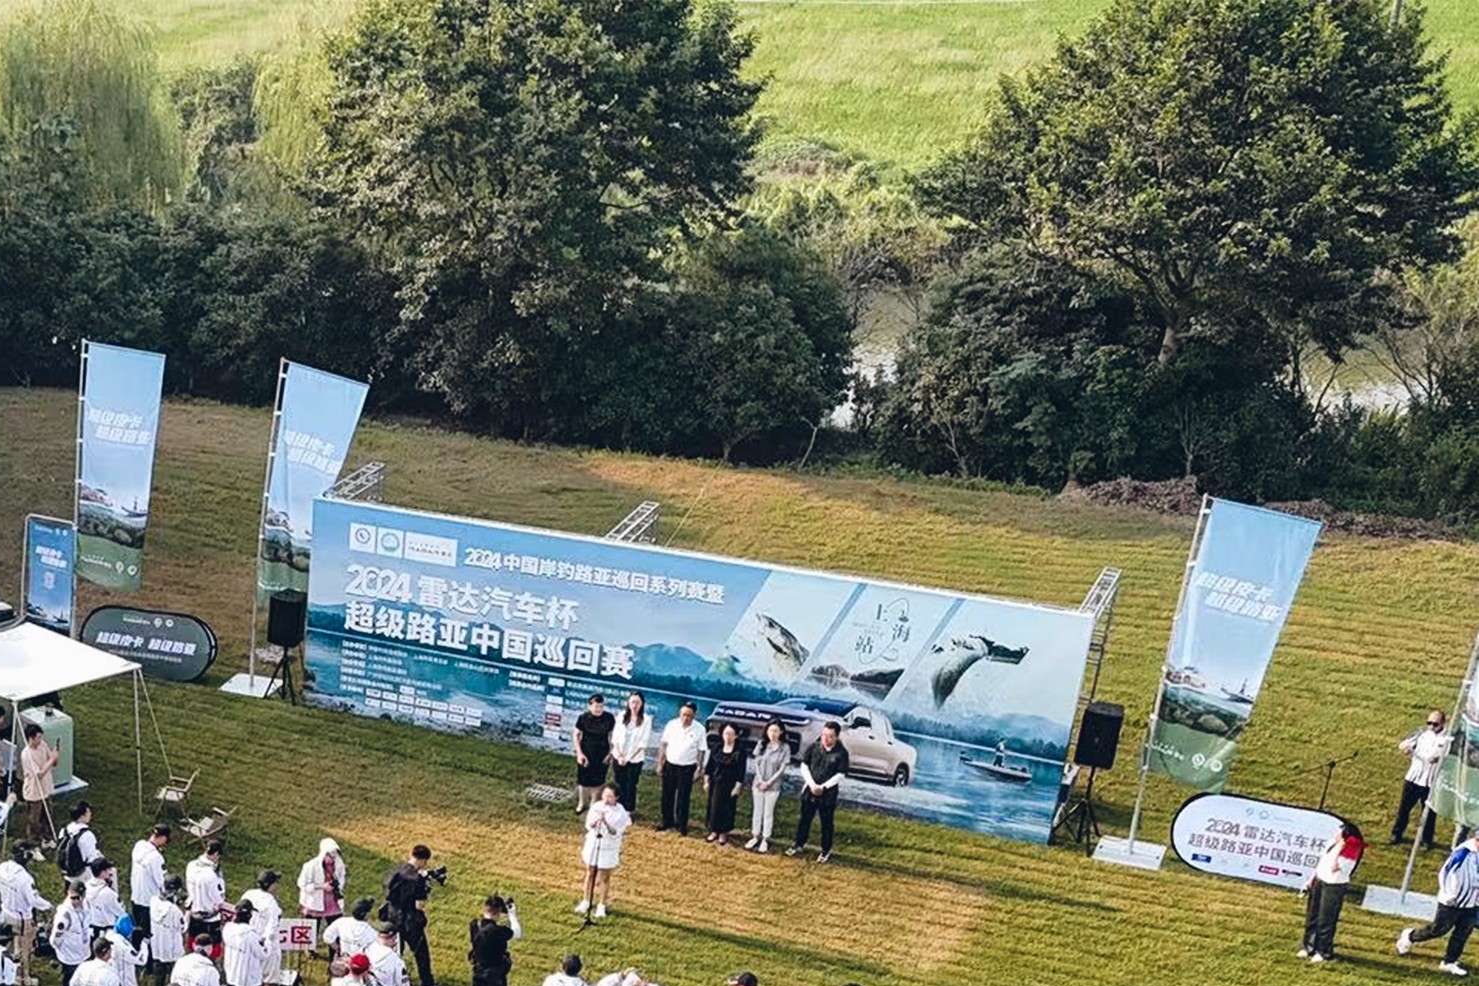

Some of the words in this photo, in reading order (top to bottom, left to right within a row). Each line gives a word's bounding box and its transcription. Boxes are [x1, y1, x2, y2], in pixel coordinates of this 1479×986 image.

[417, 574, 581, 633] 雷达汽车杯
[343, 599, 636, 681] 超级路亚中国巡回赛
